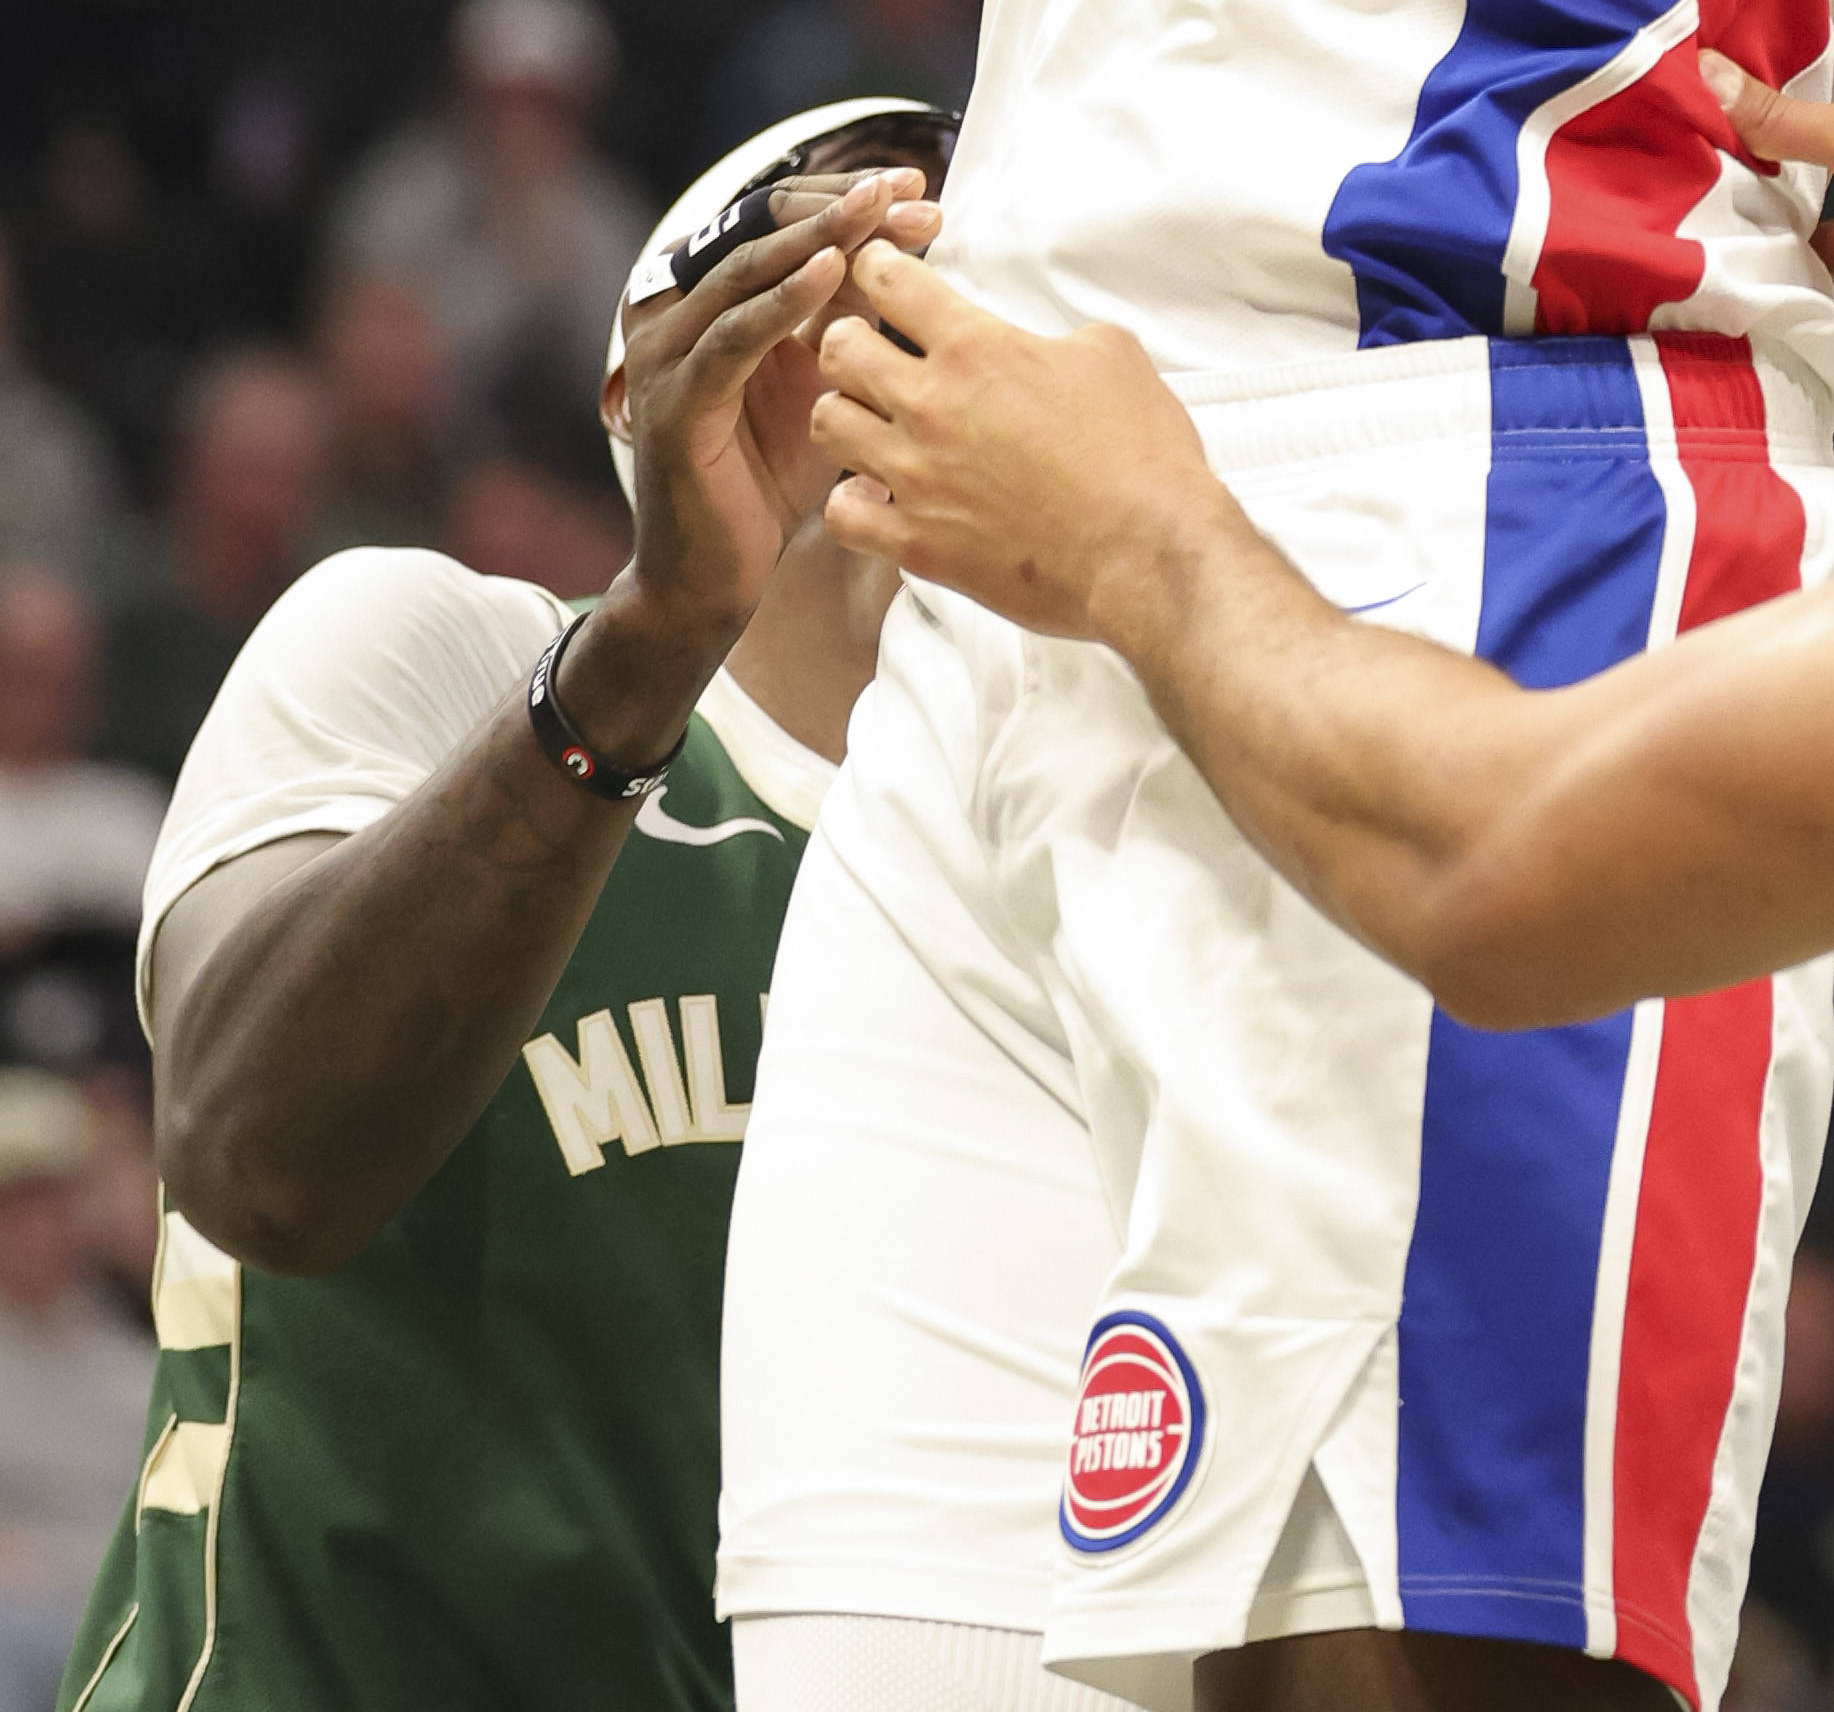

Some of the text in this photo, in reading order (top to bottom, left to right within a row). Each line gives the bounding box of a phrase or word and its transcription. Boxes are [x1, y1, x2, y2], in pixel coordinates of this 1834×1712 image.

[521, 992, 770, 1177] MIL
[1080, 1389, 1167, 1435] DETROIT
[1073, 1430, 1165, 1476] PISTONS
